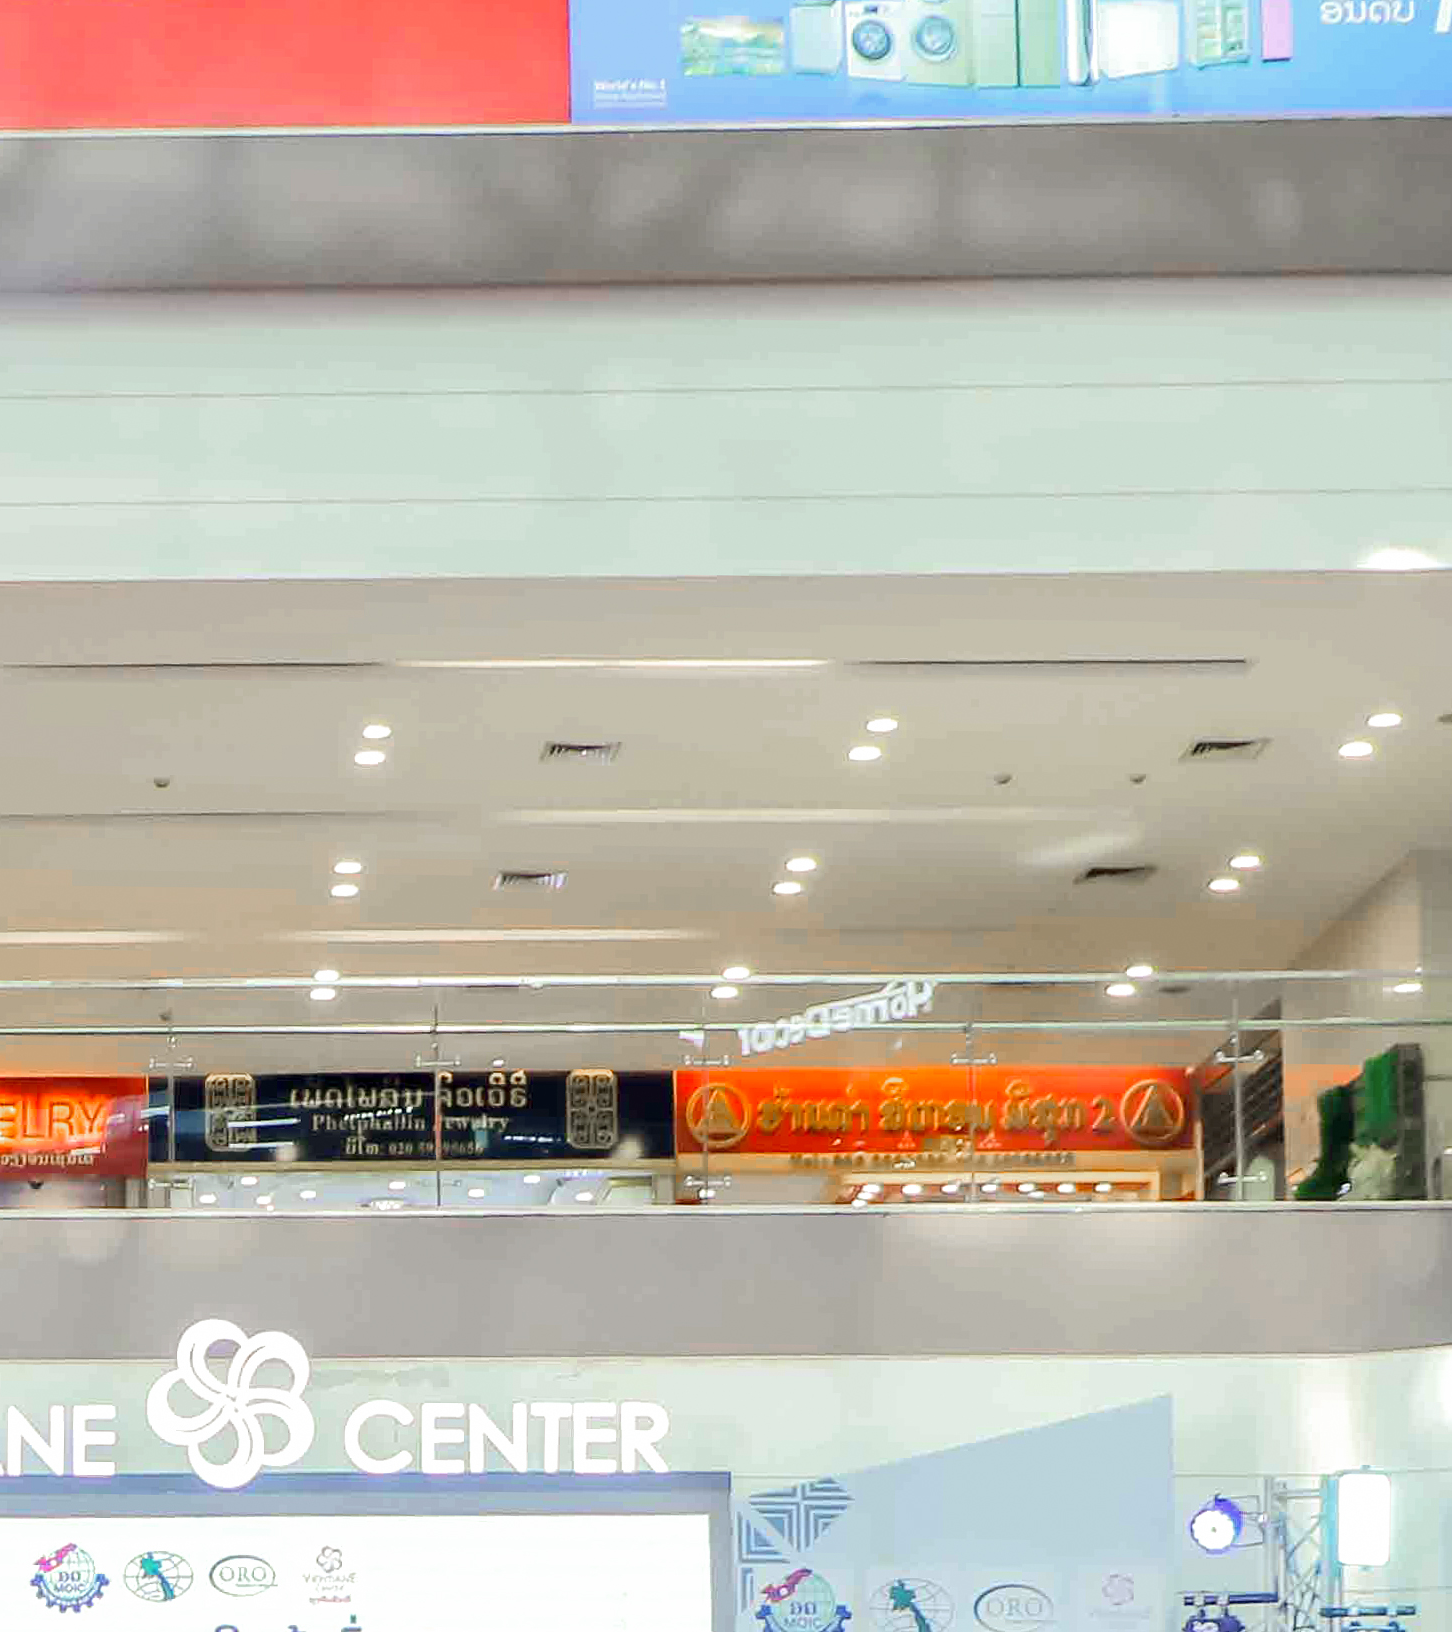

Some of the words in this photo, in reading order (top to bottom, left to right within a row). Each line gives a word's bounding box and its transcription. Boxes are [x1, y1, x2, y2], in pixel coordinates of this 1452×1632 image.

[1093, 1096, 1116, 1131] 2
[343, 1401, 671, 1475] CENTER
[219, 1565, 267, 1583] ORO
[985, 1598, 1044, 1617] ORO
